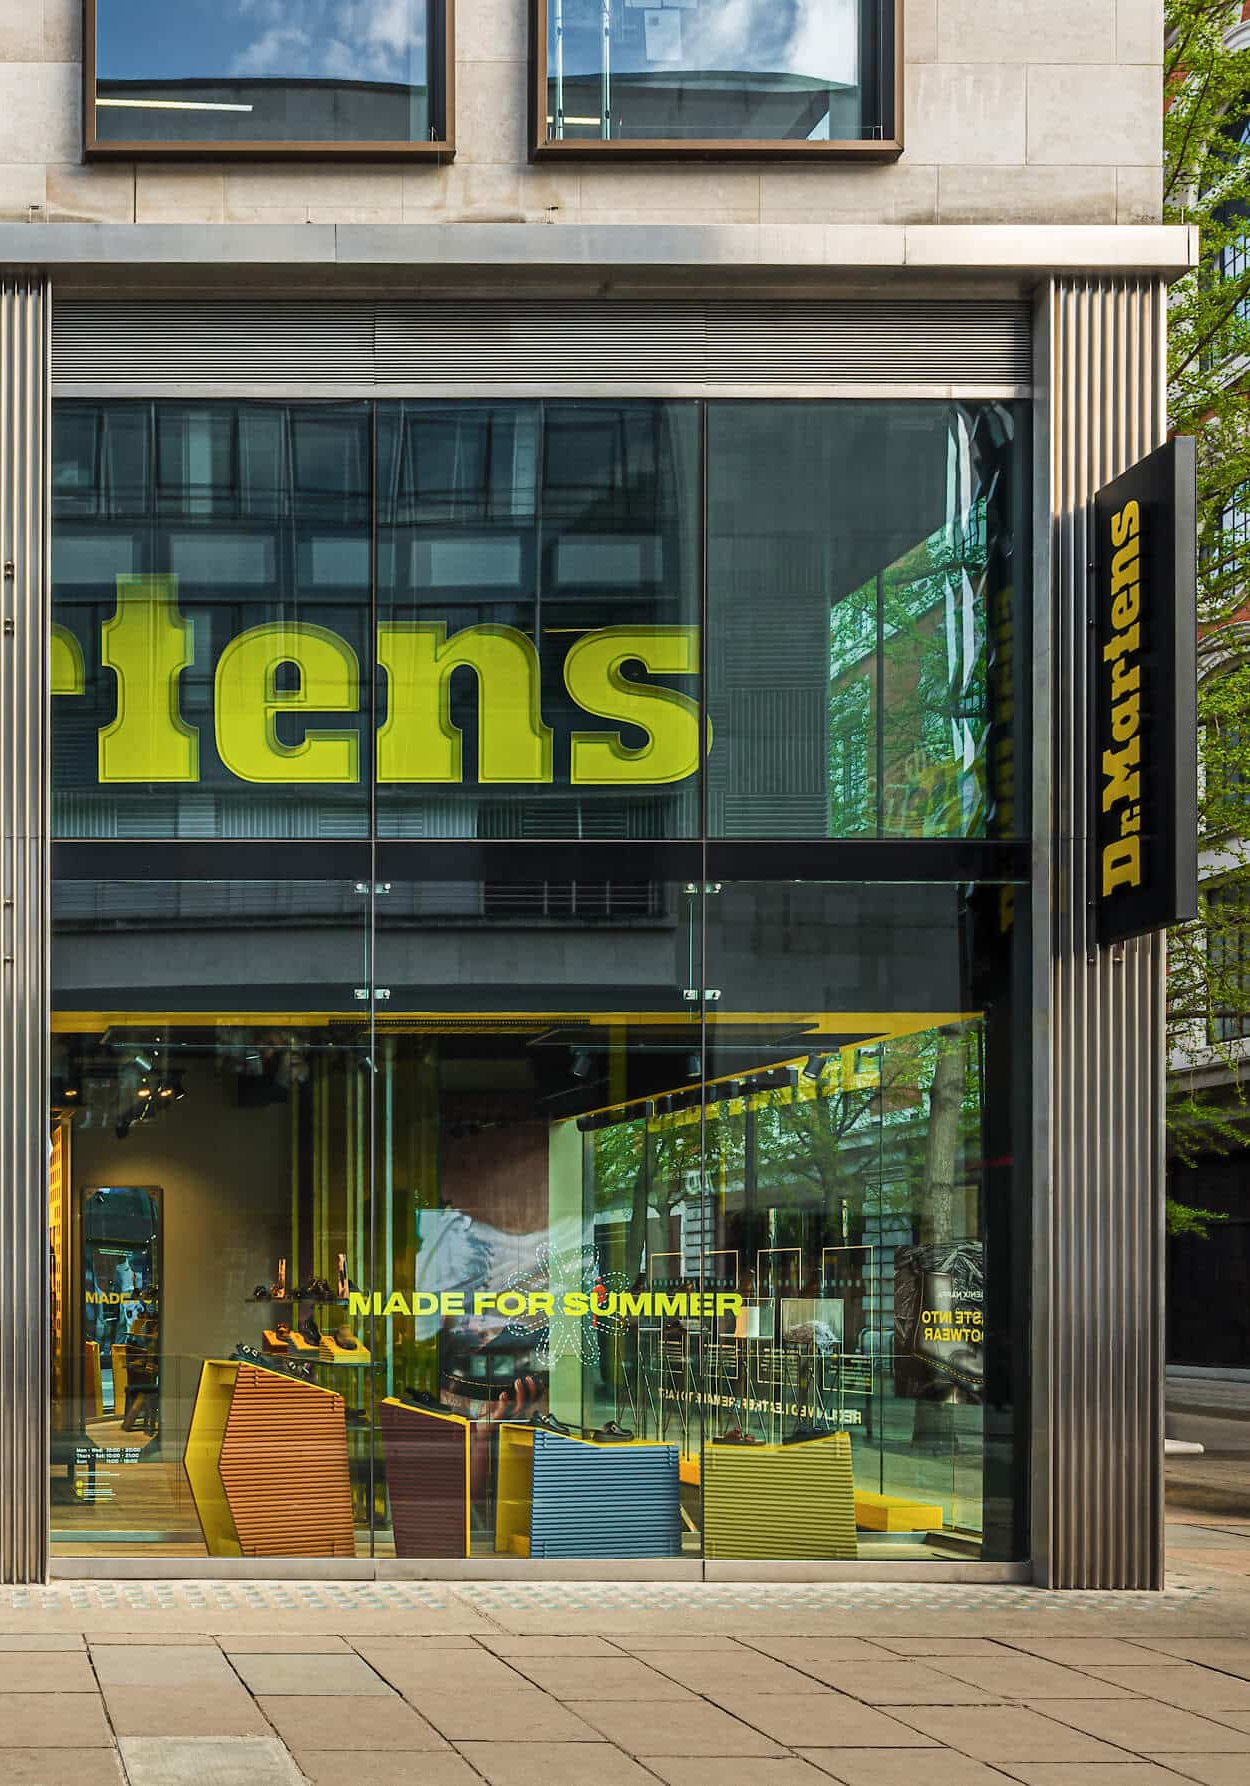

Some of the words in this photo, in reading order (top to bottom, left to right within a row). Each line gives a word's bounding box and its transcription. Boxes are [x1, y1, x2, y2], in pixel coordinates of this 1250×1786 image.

[348, 1291, 466, 1317] MADE
[473, 1291, 556, 1317] FOR
[562, 1291, 744, 1317] SUMMER
